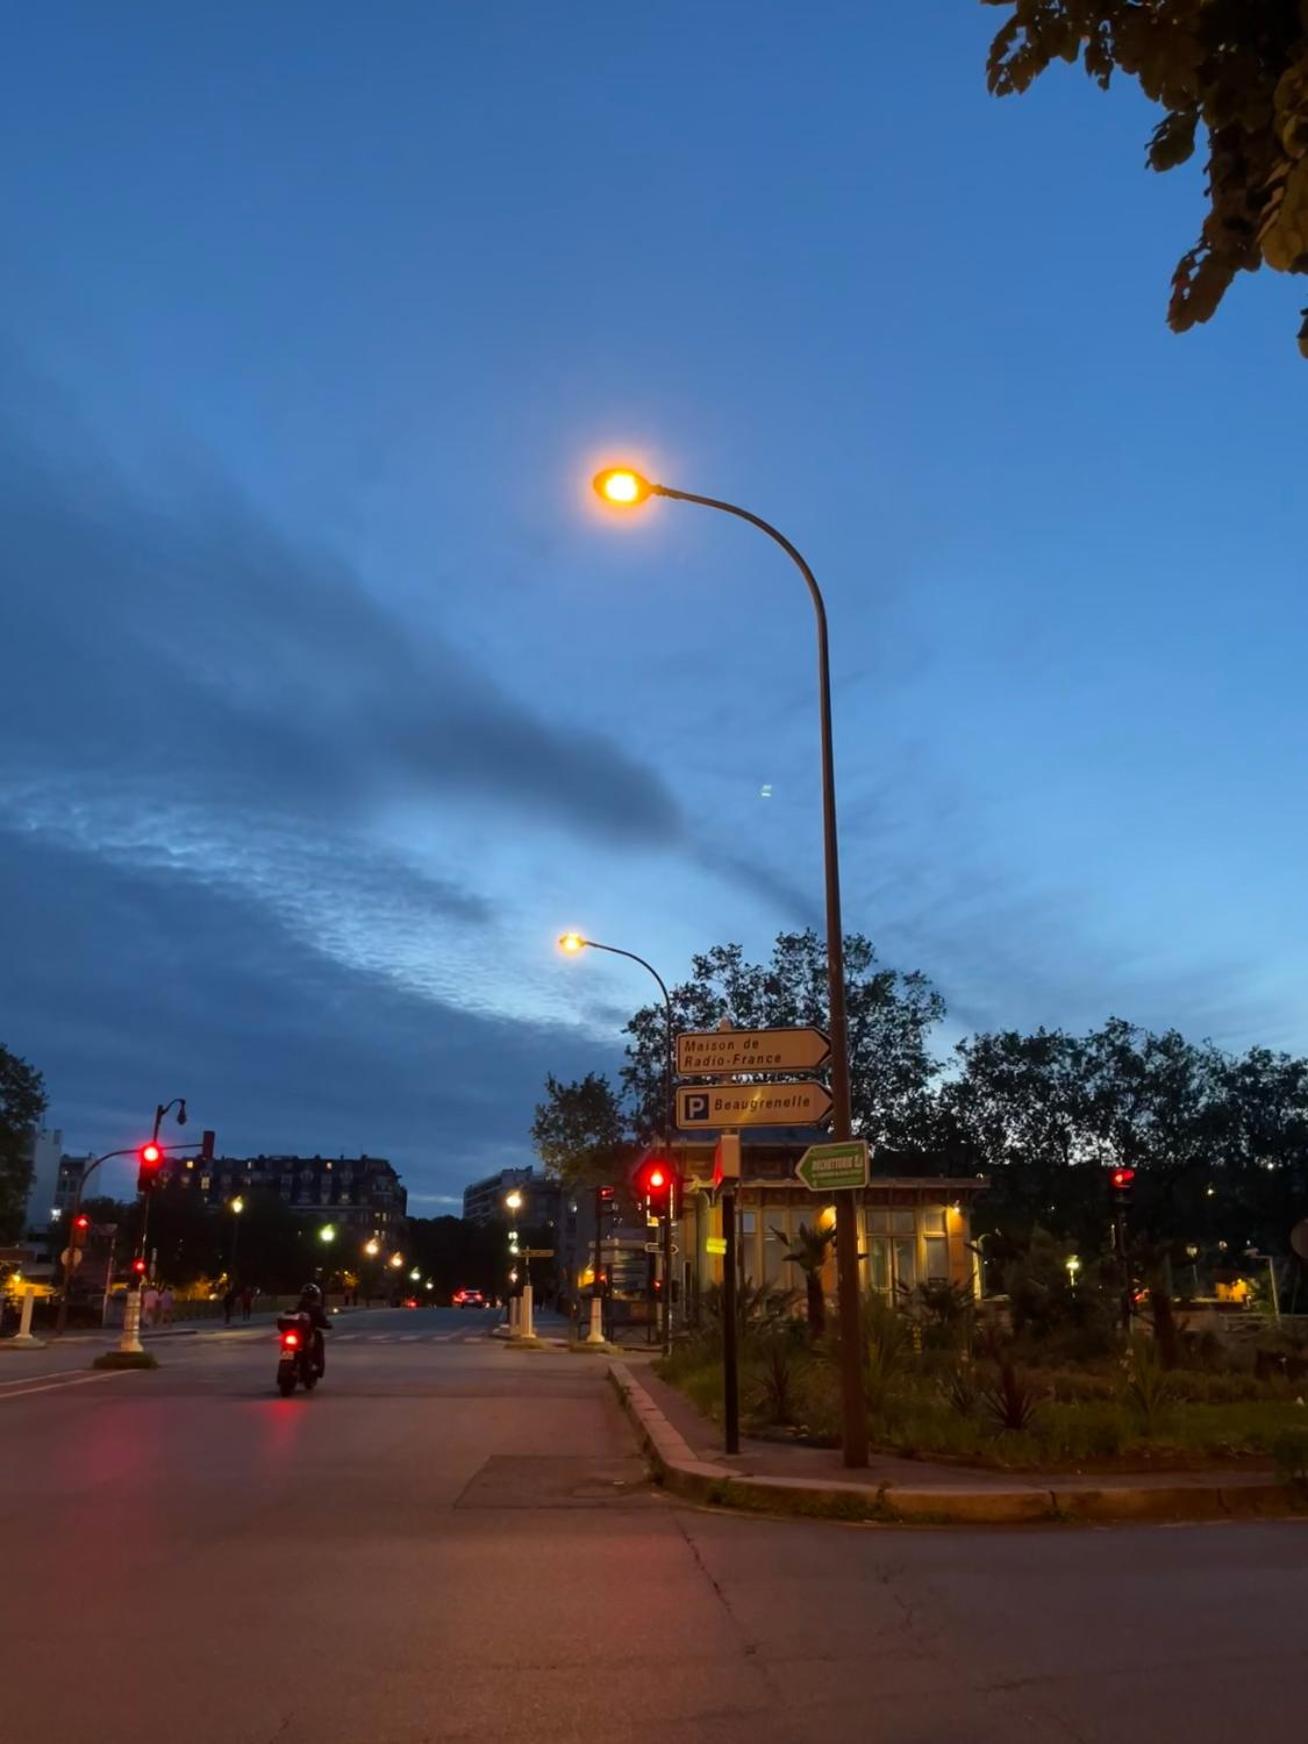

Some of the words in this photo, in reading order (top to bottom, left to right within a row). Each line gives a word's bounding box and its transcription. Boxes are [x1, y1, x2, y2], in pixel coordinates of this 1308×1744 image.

[684, 1040, 735, 1052] Maison
[743, 1038, 759, 1050] de
[684, 1053, 782, 1067] Radio-France
[689, 1097, 705, 1118] P
[714, 1095, 811, 1112] Beaugrenelle
